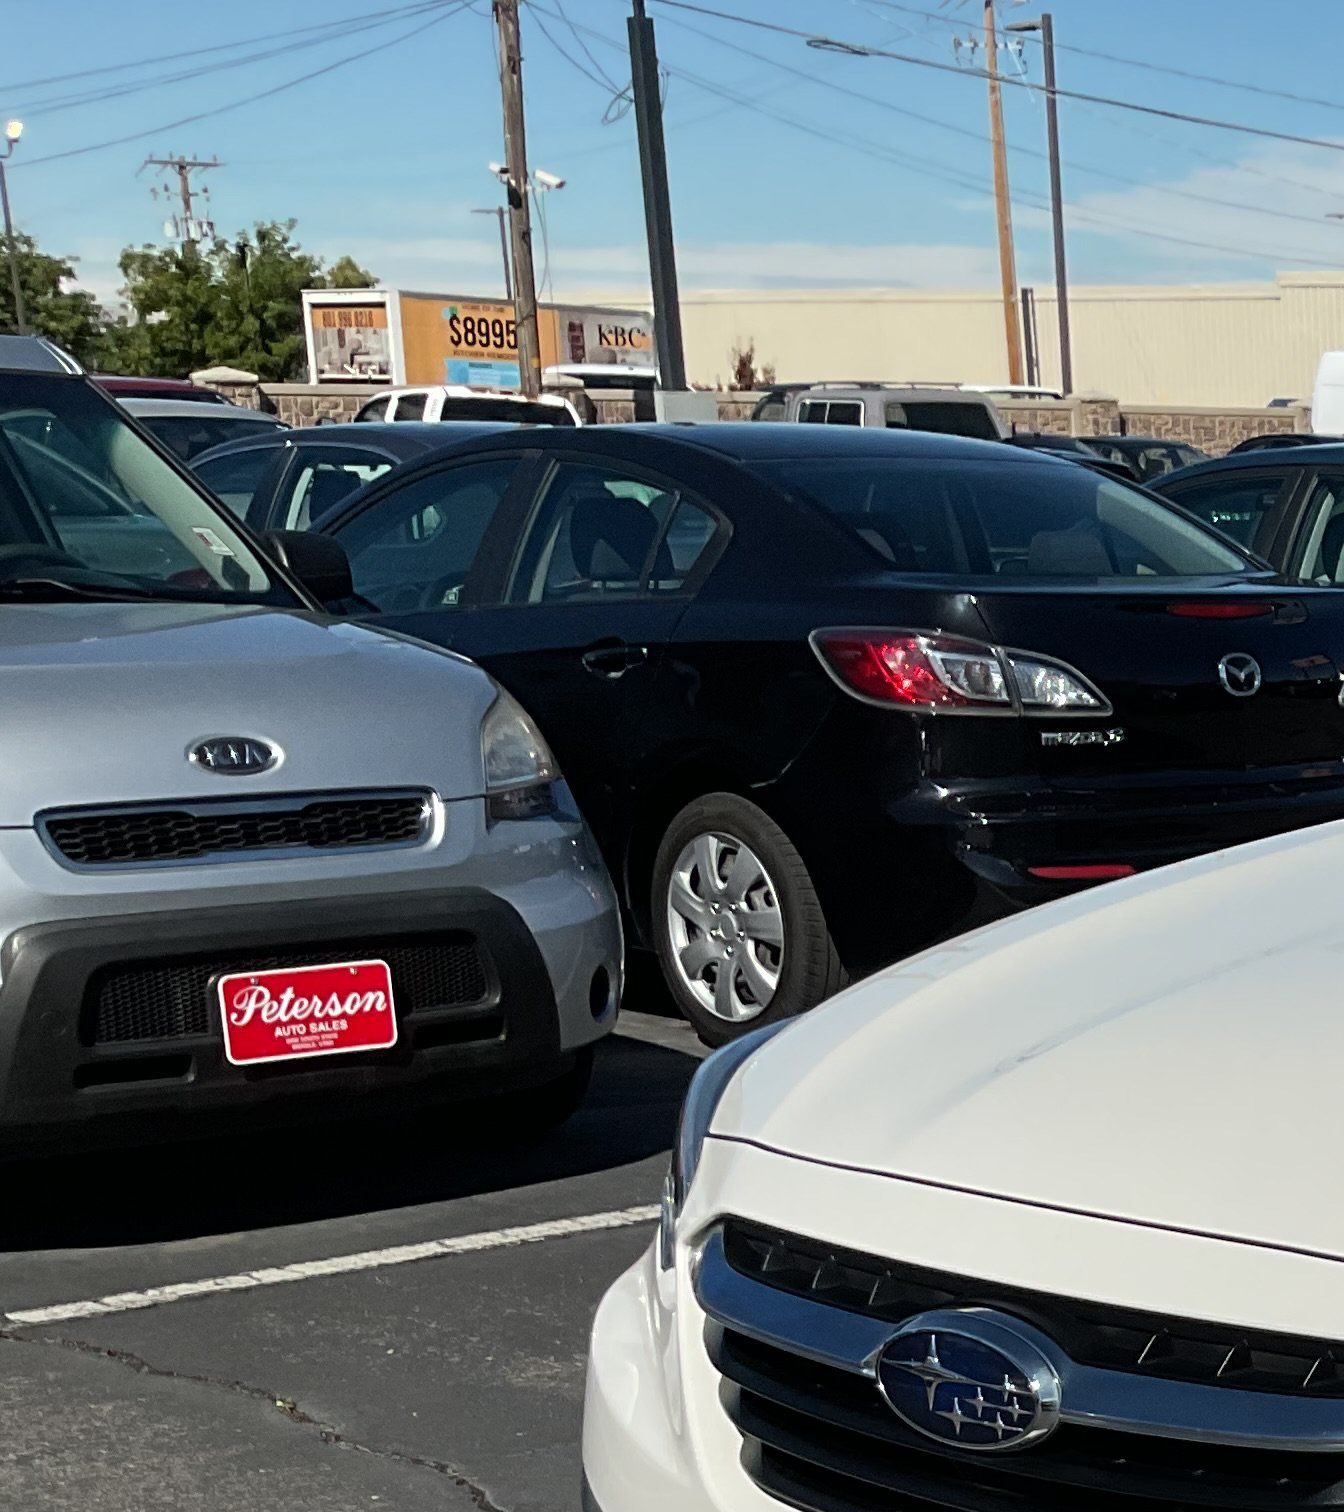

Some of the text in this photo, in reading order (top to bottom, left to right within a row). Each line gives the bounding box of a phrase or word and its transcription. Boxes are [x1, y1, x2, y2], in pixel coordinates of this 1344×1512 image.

[449, 313, 519, 350] $8995
[230, 985, 388, 1027] Peterson
[274, 1022, 306, 1039] AUTO
[309, 1018, 349, 1035] SALES
